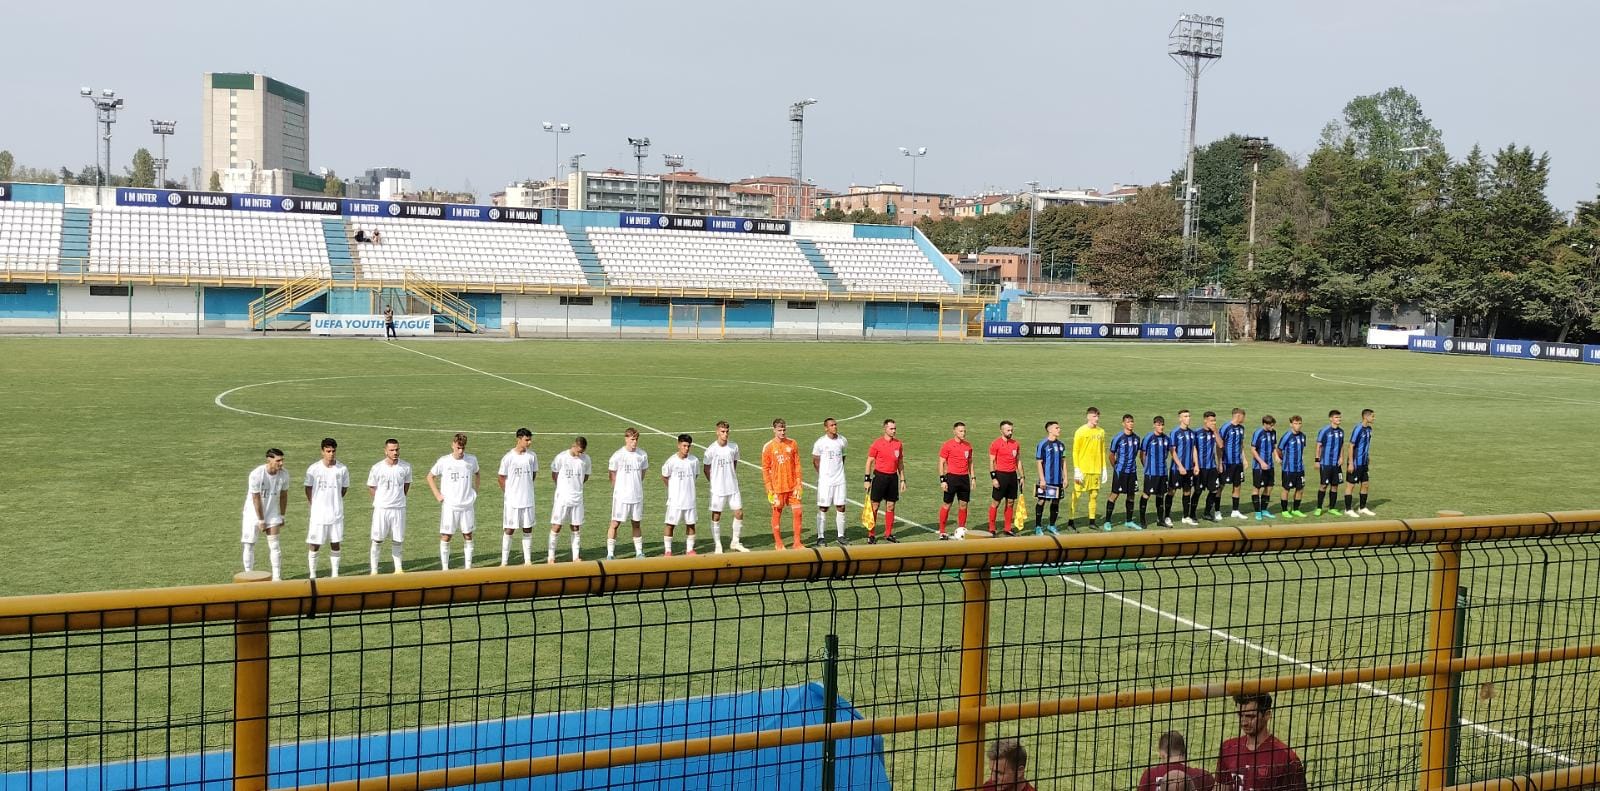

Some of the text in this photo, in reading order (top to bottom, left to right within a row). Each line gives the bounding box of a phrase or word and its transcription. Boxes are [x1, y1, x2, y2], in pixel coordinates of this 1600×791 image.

[137, 193, 157, 202] INTER
[200, 196, 227, 206] MILANO
[252, 198, 271, 208] INTER
[312, 201, 337, 211] MILANO
[361, 204, 379, 212] INTER
[418, 206, 440, 216] MILANO
[463, 209, 480, 217] INTER
[516, 211, 537, 220] MILANO
[683, 219, 703, 227] MILANO
[315, 320, 430, 329] UEFA YOUTH EAGUE
